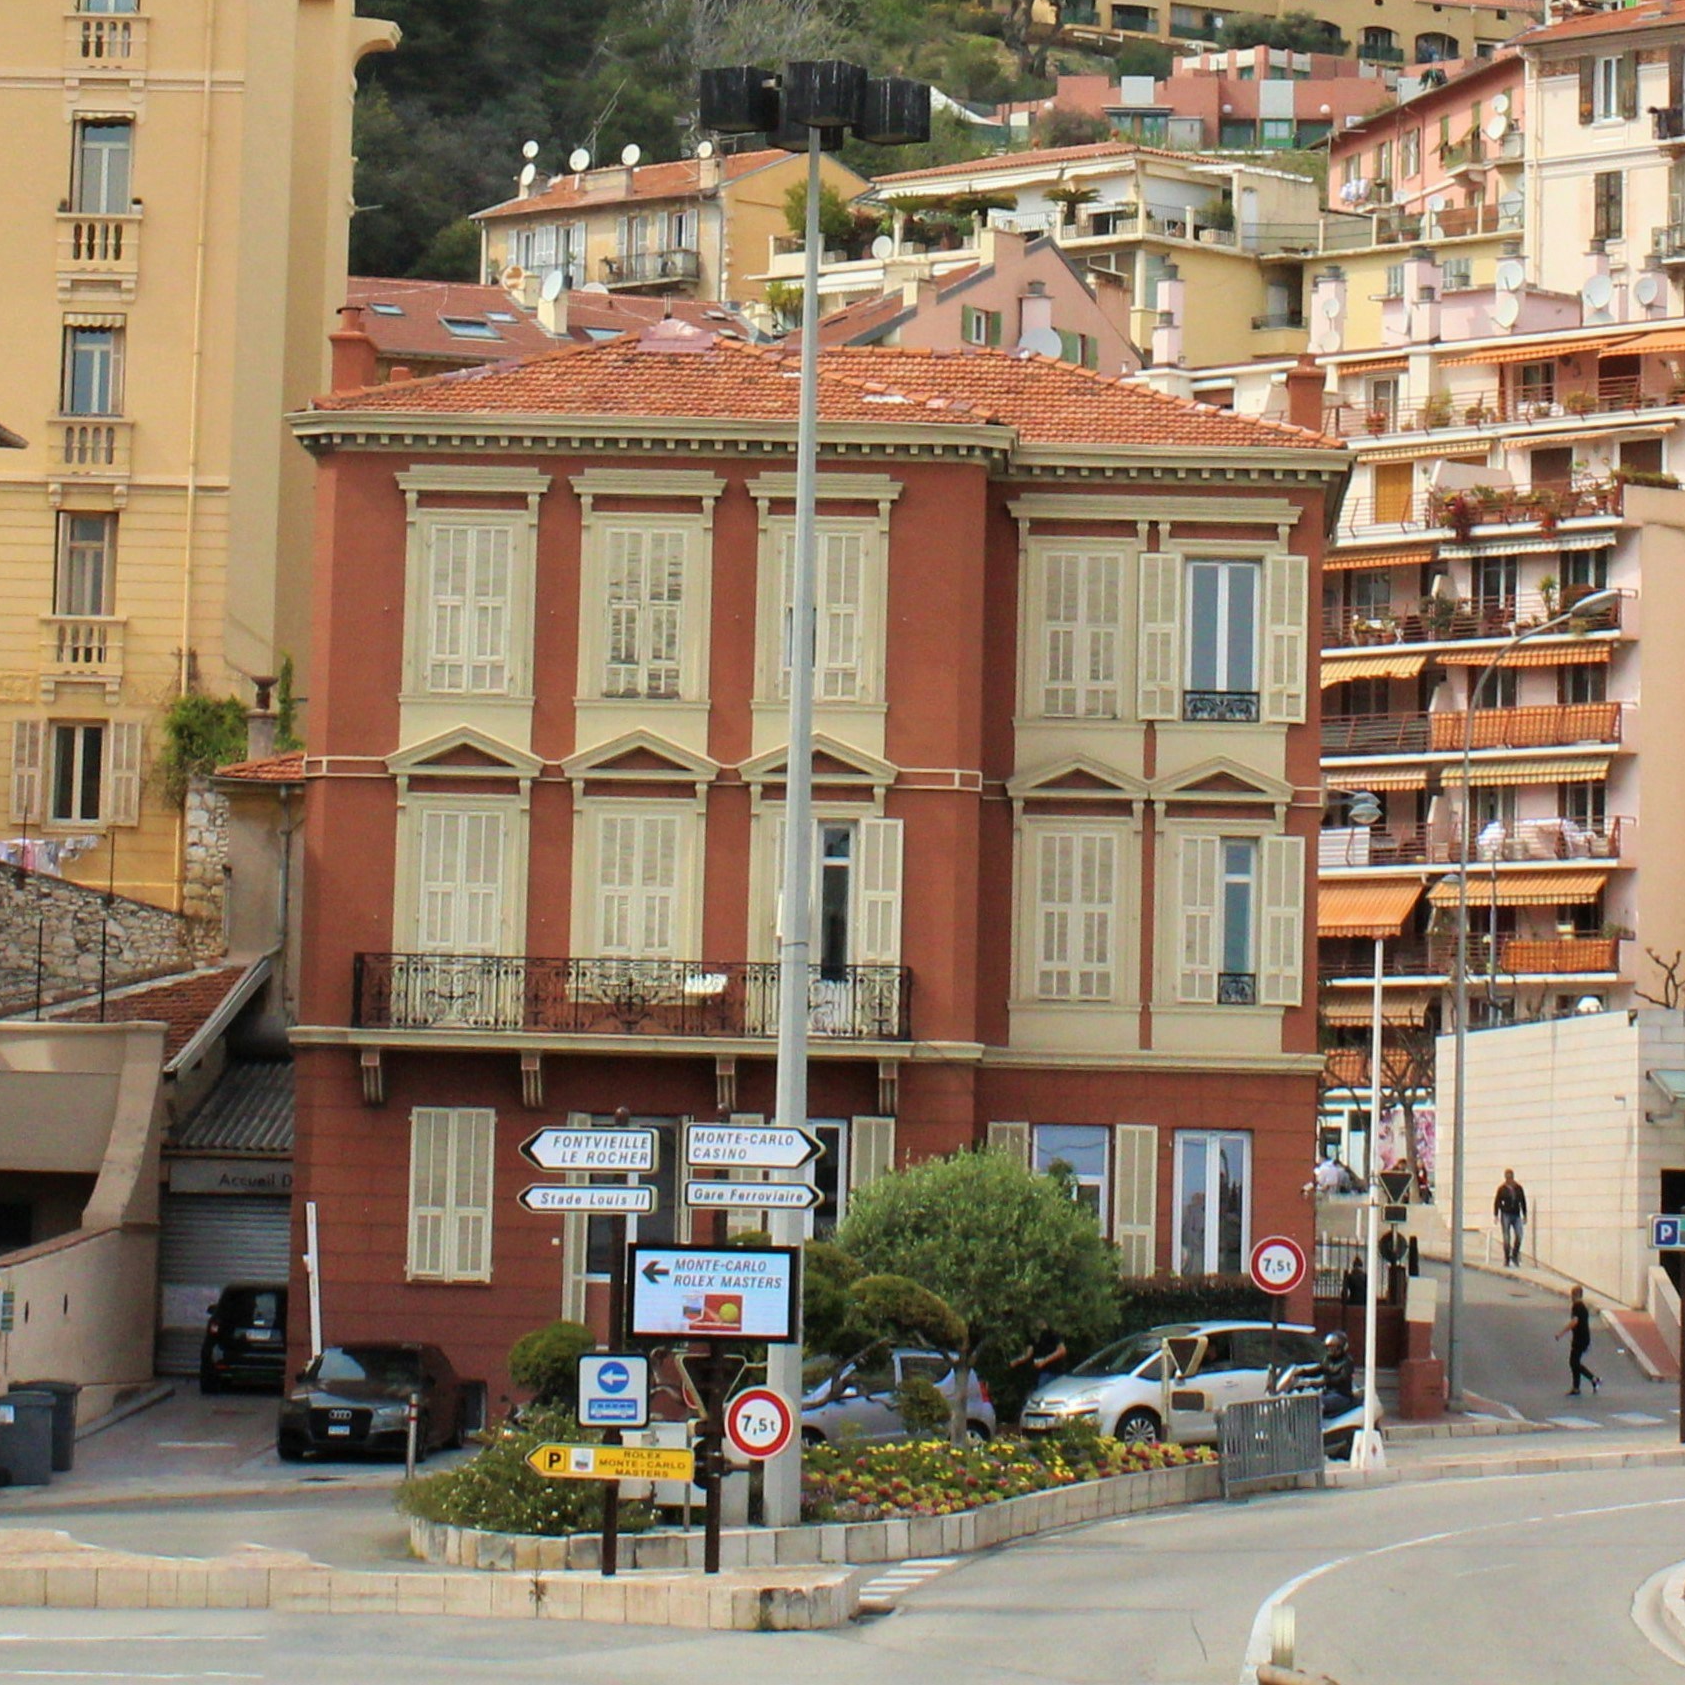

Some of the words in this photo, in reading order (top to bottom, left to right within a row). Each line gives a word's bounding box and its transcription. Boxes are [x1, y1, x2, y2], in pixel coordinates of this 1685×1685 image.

[553, 1135, 649, 1149] FONTVIEILLE
[693, 1132, 794, 1146] MONTE-CARLO
[561, 1150, 577, 1163] LE
[586, 1150, 649, 1164] ROCHER
[693, 1147, 747, 1160] CASINO
[219, 1173, 275, 1187] Accueil
[540, 1192, 582, 1205] Stade
[590, 1192, 627, 1205] Louis
[634, 1193, 646, 1206] II
[693, 1187, 724, 1201] Gare
[729, 1188, 803, 1203] Ferroviaire
[1660, 1223, 1673, 1241] P
[674, 1258, 767, 1272] MONTE-CARLO
[673, 1274, 716, 1287] ROLEX
[720, 1276, 782, 1289] MASTERS
[548, 1452, 561, 1468] P
[623, 1450, 661, 1460] ROLEX
[615, 1468, 669, 1479] MASTERS
